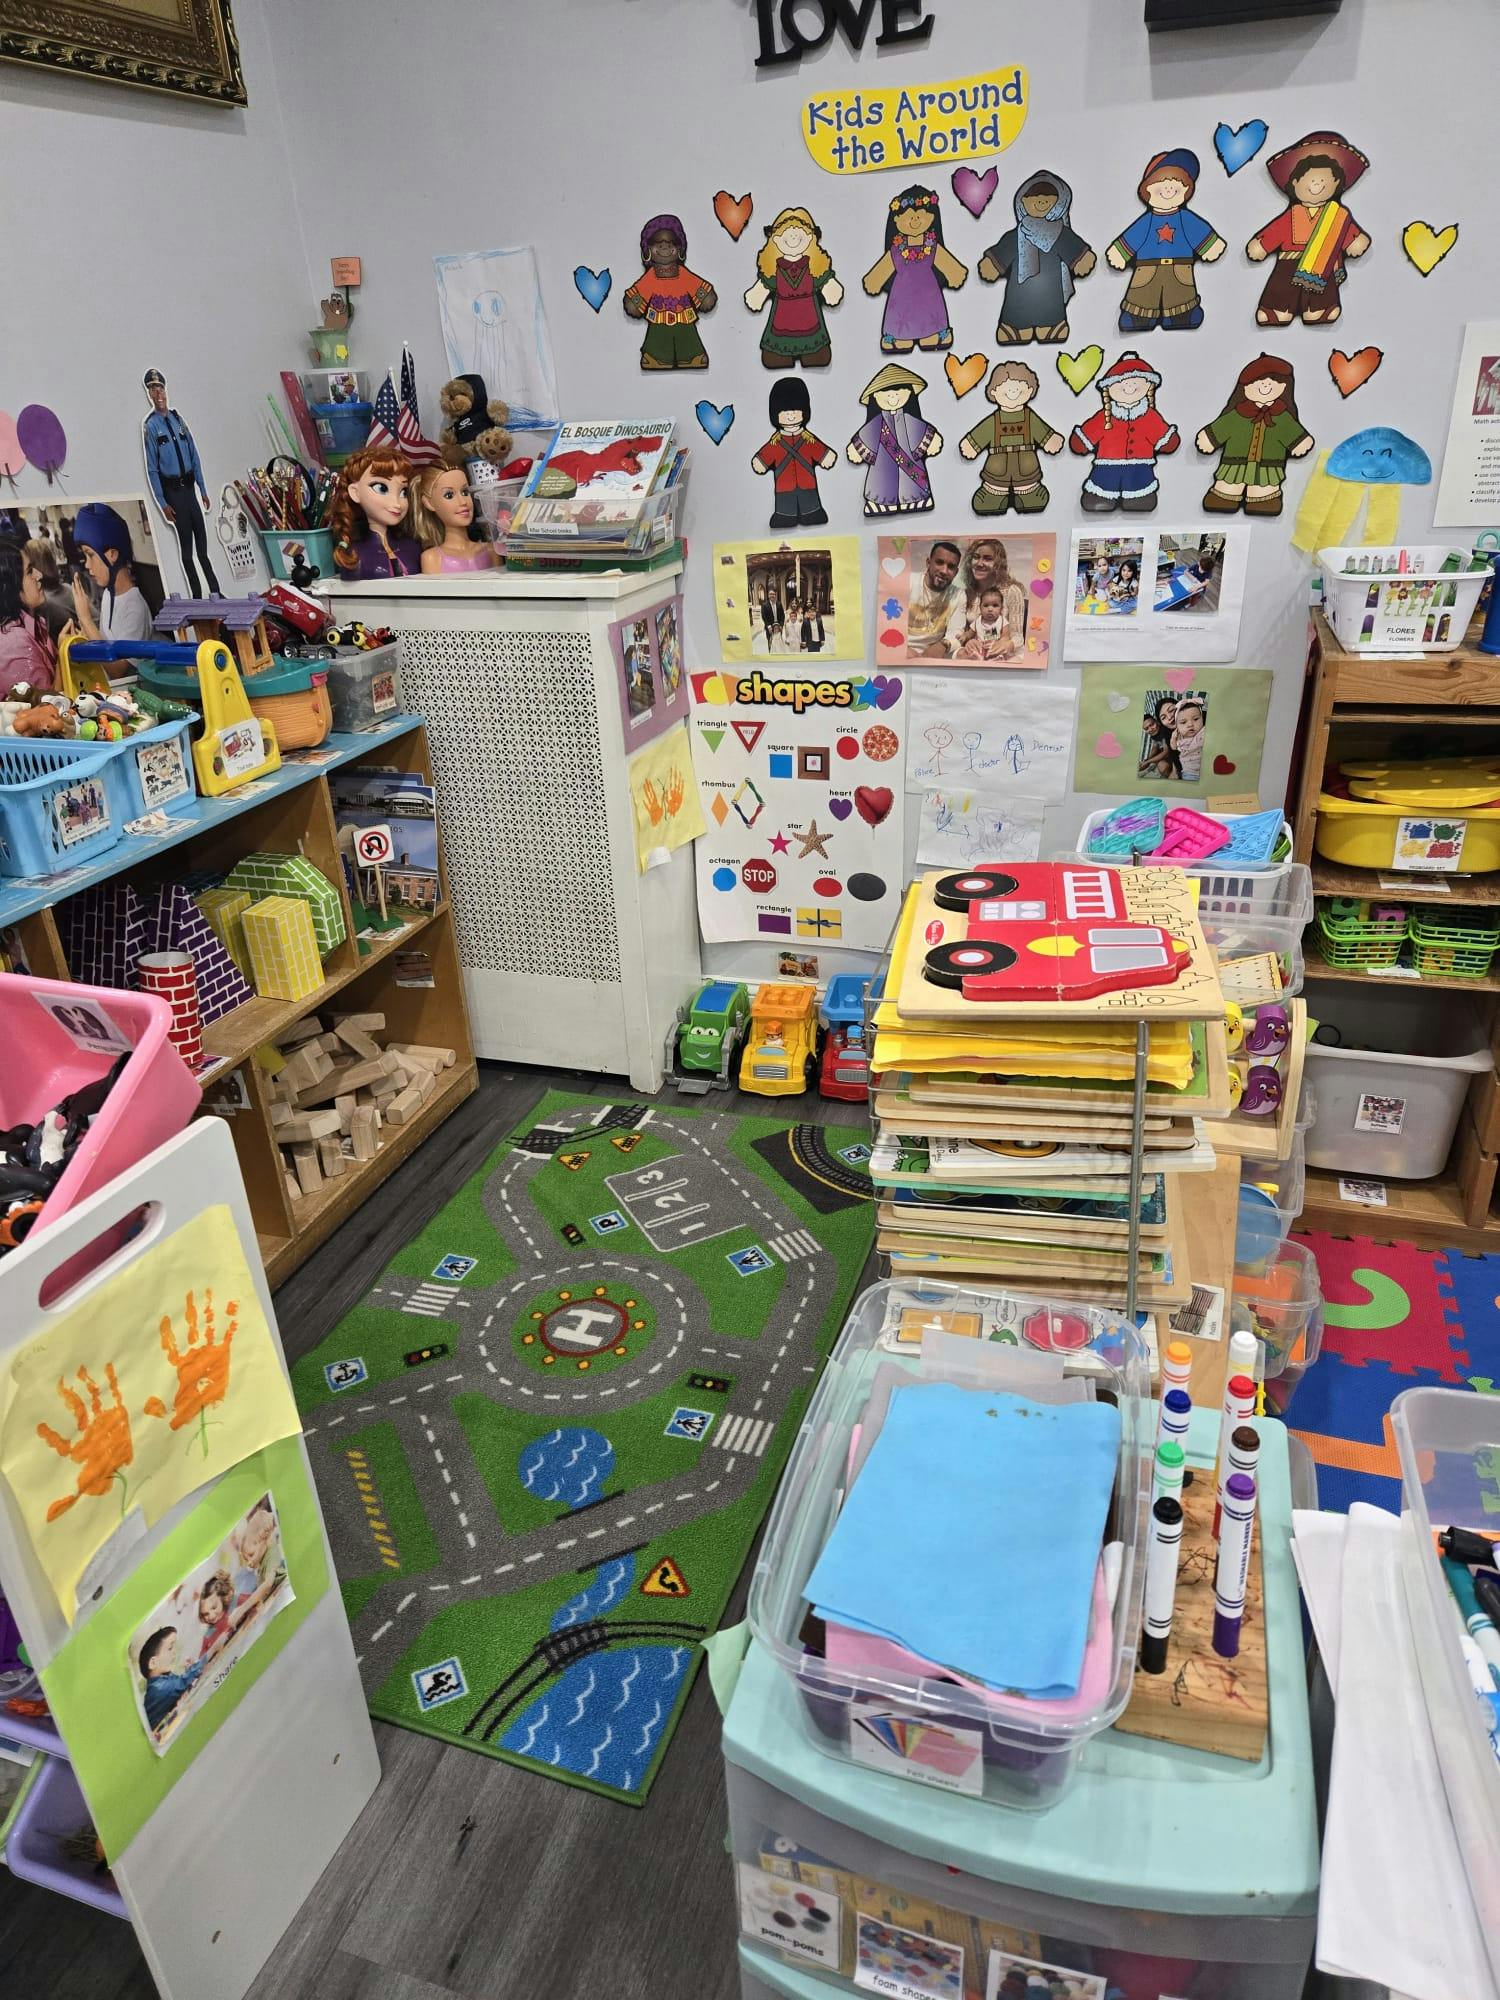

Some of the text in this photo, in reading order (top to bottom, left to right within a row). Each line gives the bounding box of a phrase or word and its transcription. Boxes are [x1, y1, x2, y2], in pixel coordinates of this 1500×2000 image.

[755, 0, 935, 67] LOVE
[808, 70, 1023, 135] Kids Around
[832, 113, 1000, 169] the World
[560, 422, 672, 439] EL BOSQUE DINOSAURIO
[1386, 627, 1416, 635] FLORES
[736, 671, 853, 714] shapes
[697, 719, 728, 729] triangle
[836, 725, 858, 734] circle
[767, 743, 794, 753] square
[701, 780, 736, 788] rhombus
[829, 788, 852, 797] heart
[787, 822, 803, 830] star
[708, 857, 741, 865] octagon
[743, 868, 774, 883] STOP
[818, 868, 837, 876] oval
[756, 903, 792, 913] rectangle
[552, 1309, 616, 1347] H
[761, 1927, 825, 1957] pom-poms
[872, 1974, 898, 1992] foam
